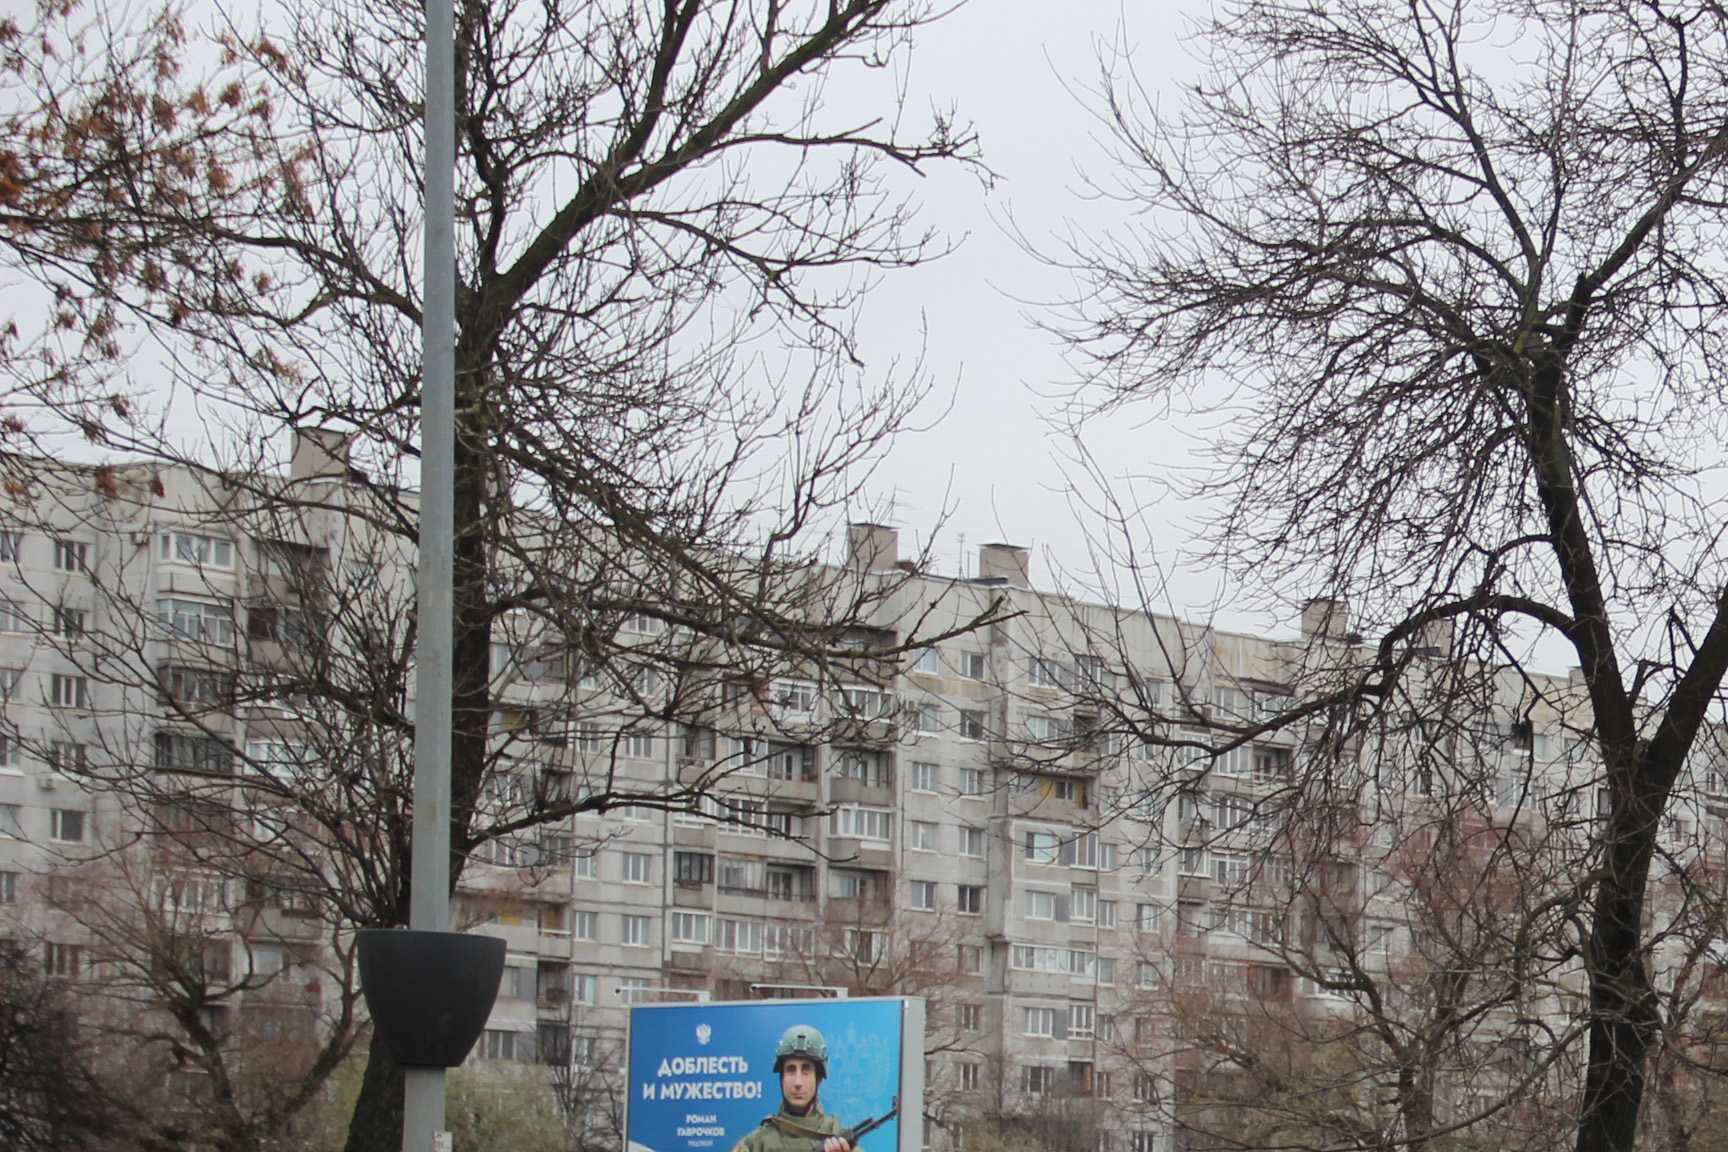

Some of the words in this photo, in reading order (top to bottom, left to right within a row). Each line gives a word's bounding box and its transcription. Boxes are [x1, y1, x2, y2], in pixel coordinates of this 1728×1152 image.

[657, 1056, 749, 1077] ДОБЛЕСТЬ
[642, 1083, 656, 1100] И
[660, 1081, 763, 1100] МУЖЕСТВО!
[686, 1114, 717, 1124] РОМАН
